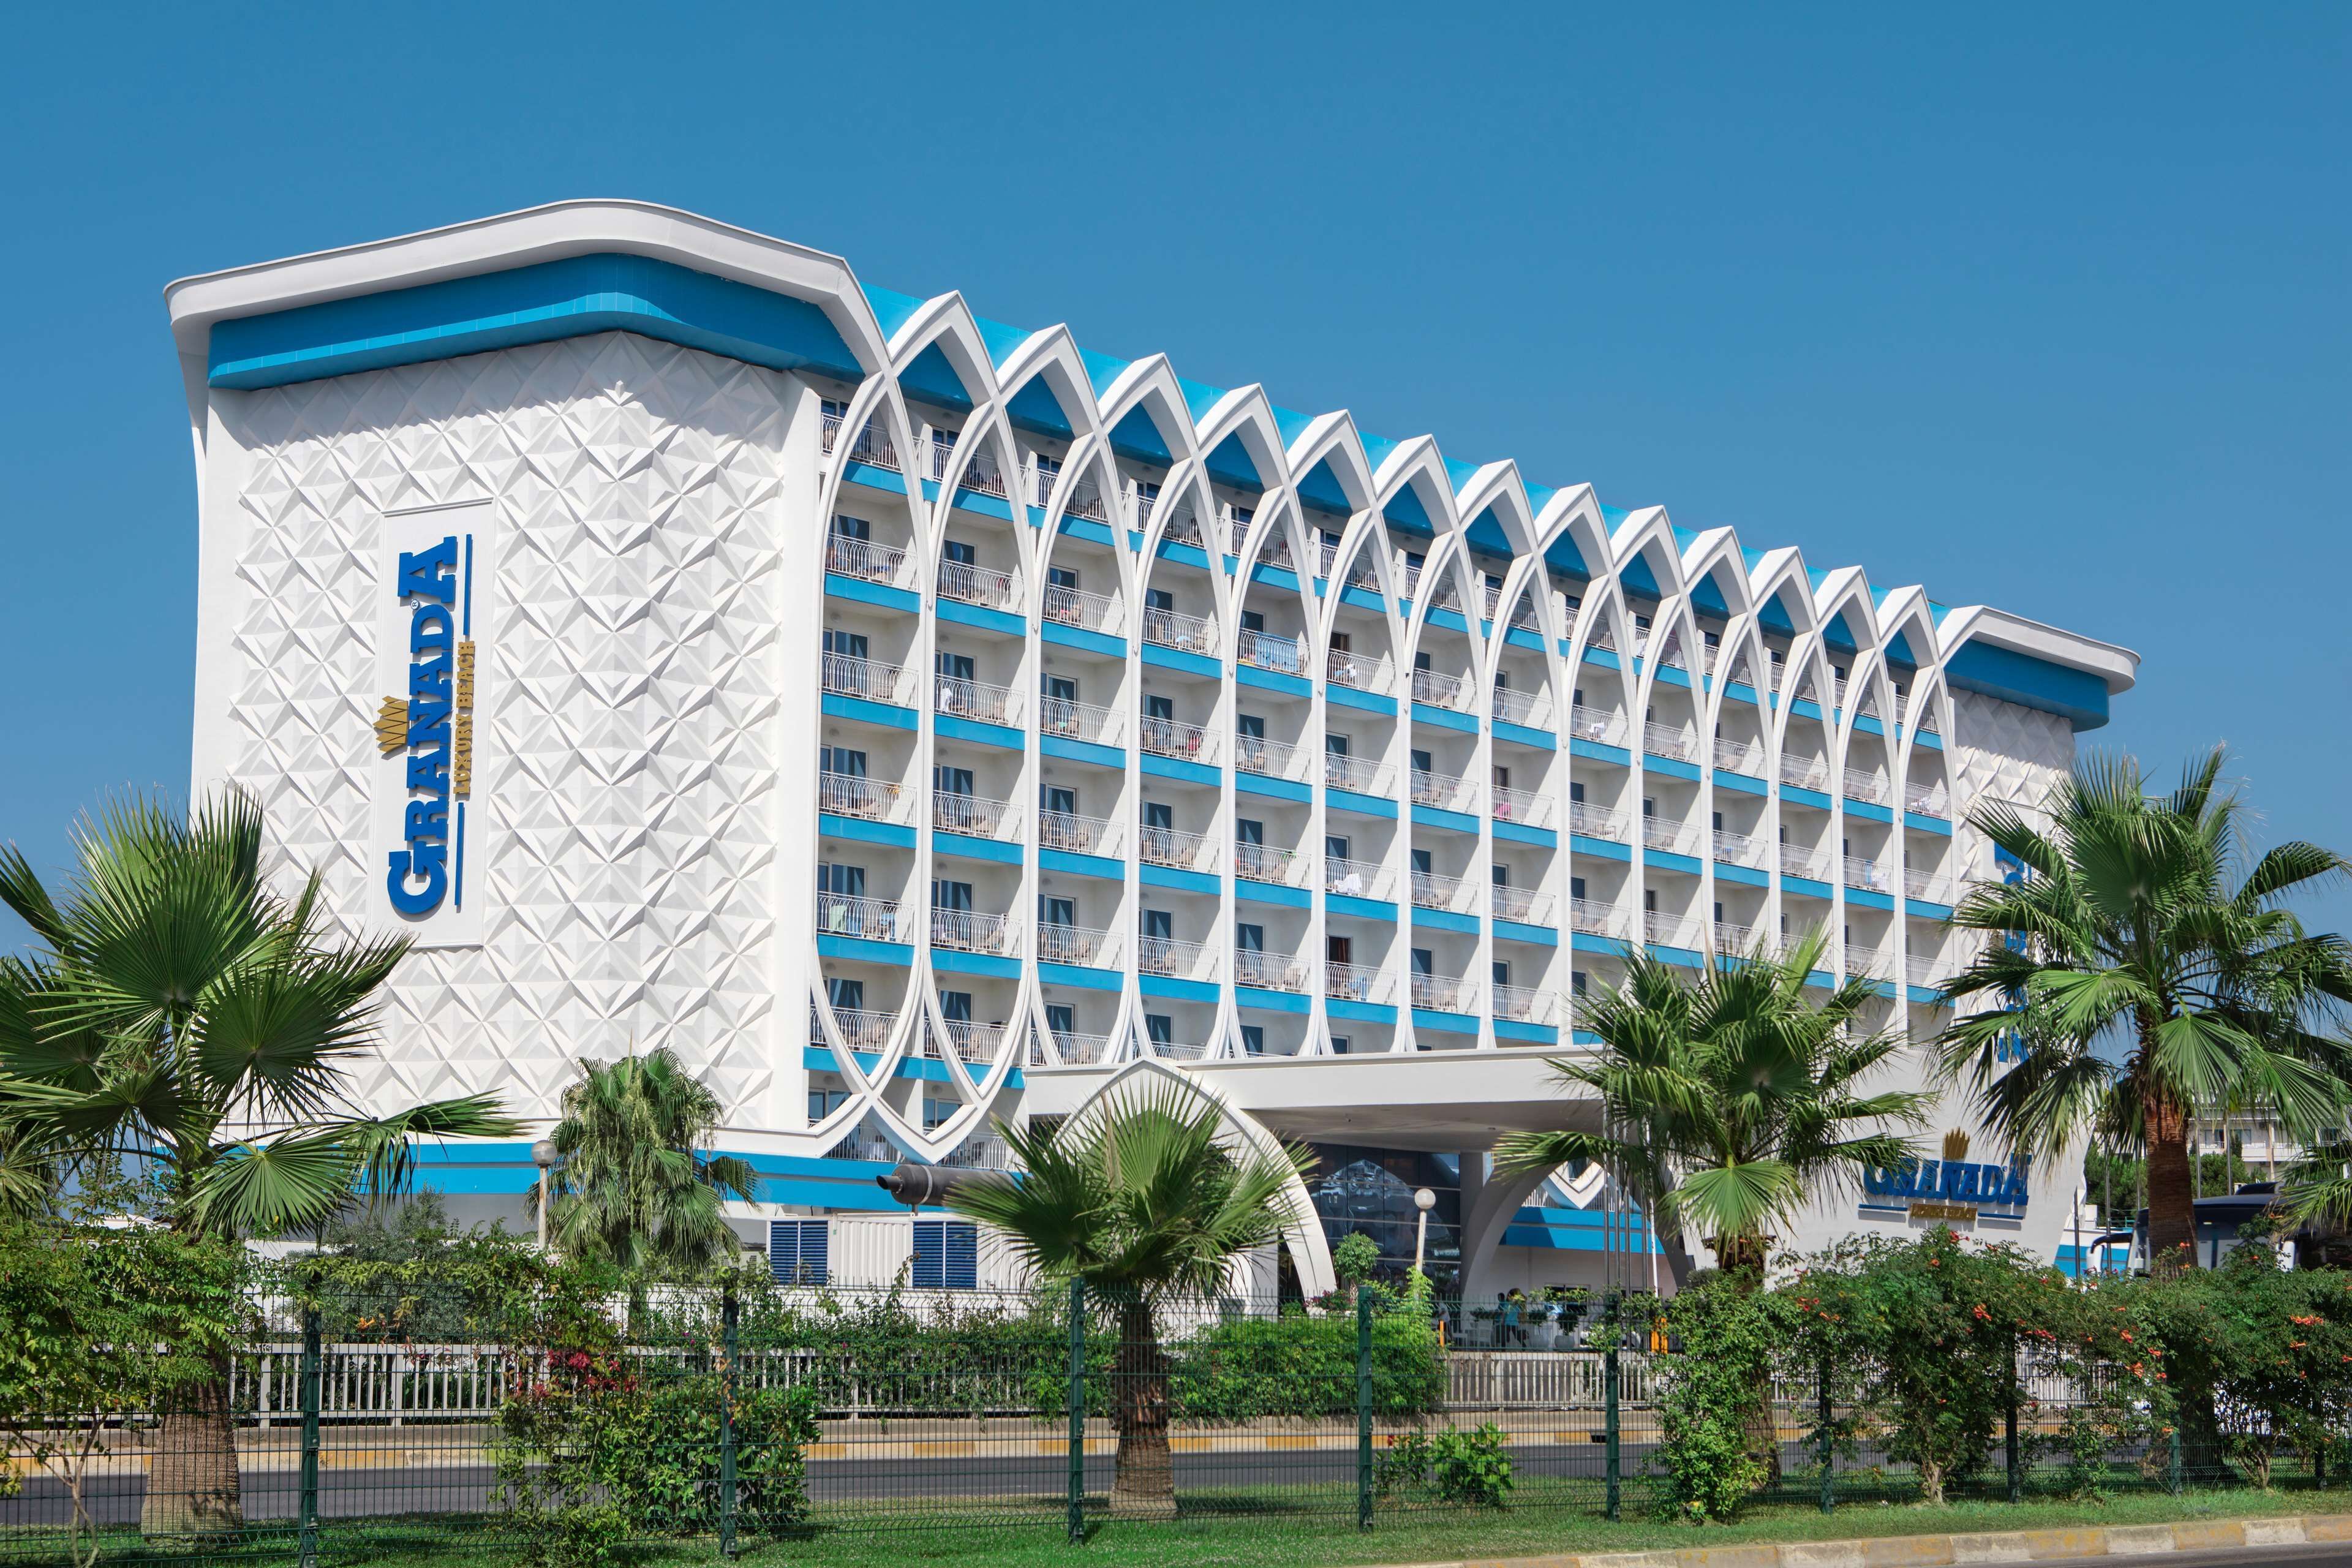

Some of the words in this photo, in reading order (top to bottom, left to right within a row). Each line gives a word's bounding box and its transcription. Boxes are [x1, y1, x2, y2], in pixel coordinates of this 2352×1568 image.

[457, 641, 475, 709] BEACH
[387, 536, 458, 914] GRANADA
[453, 714, 473, 795] LUXURY
